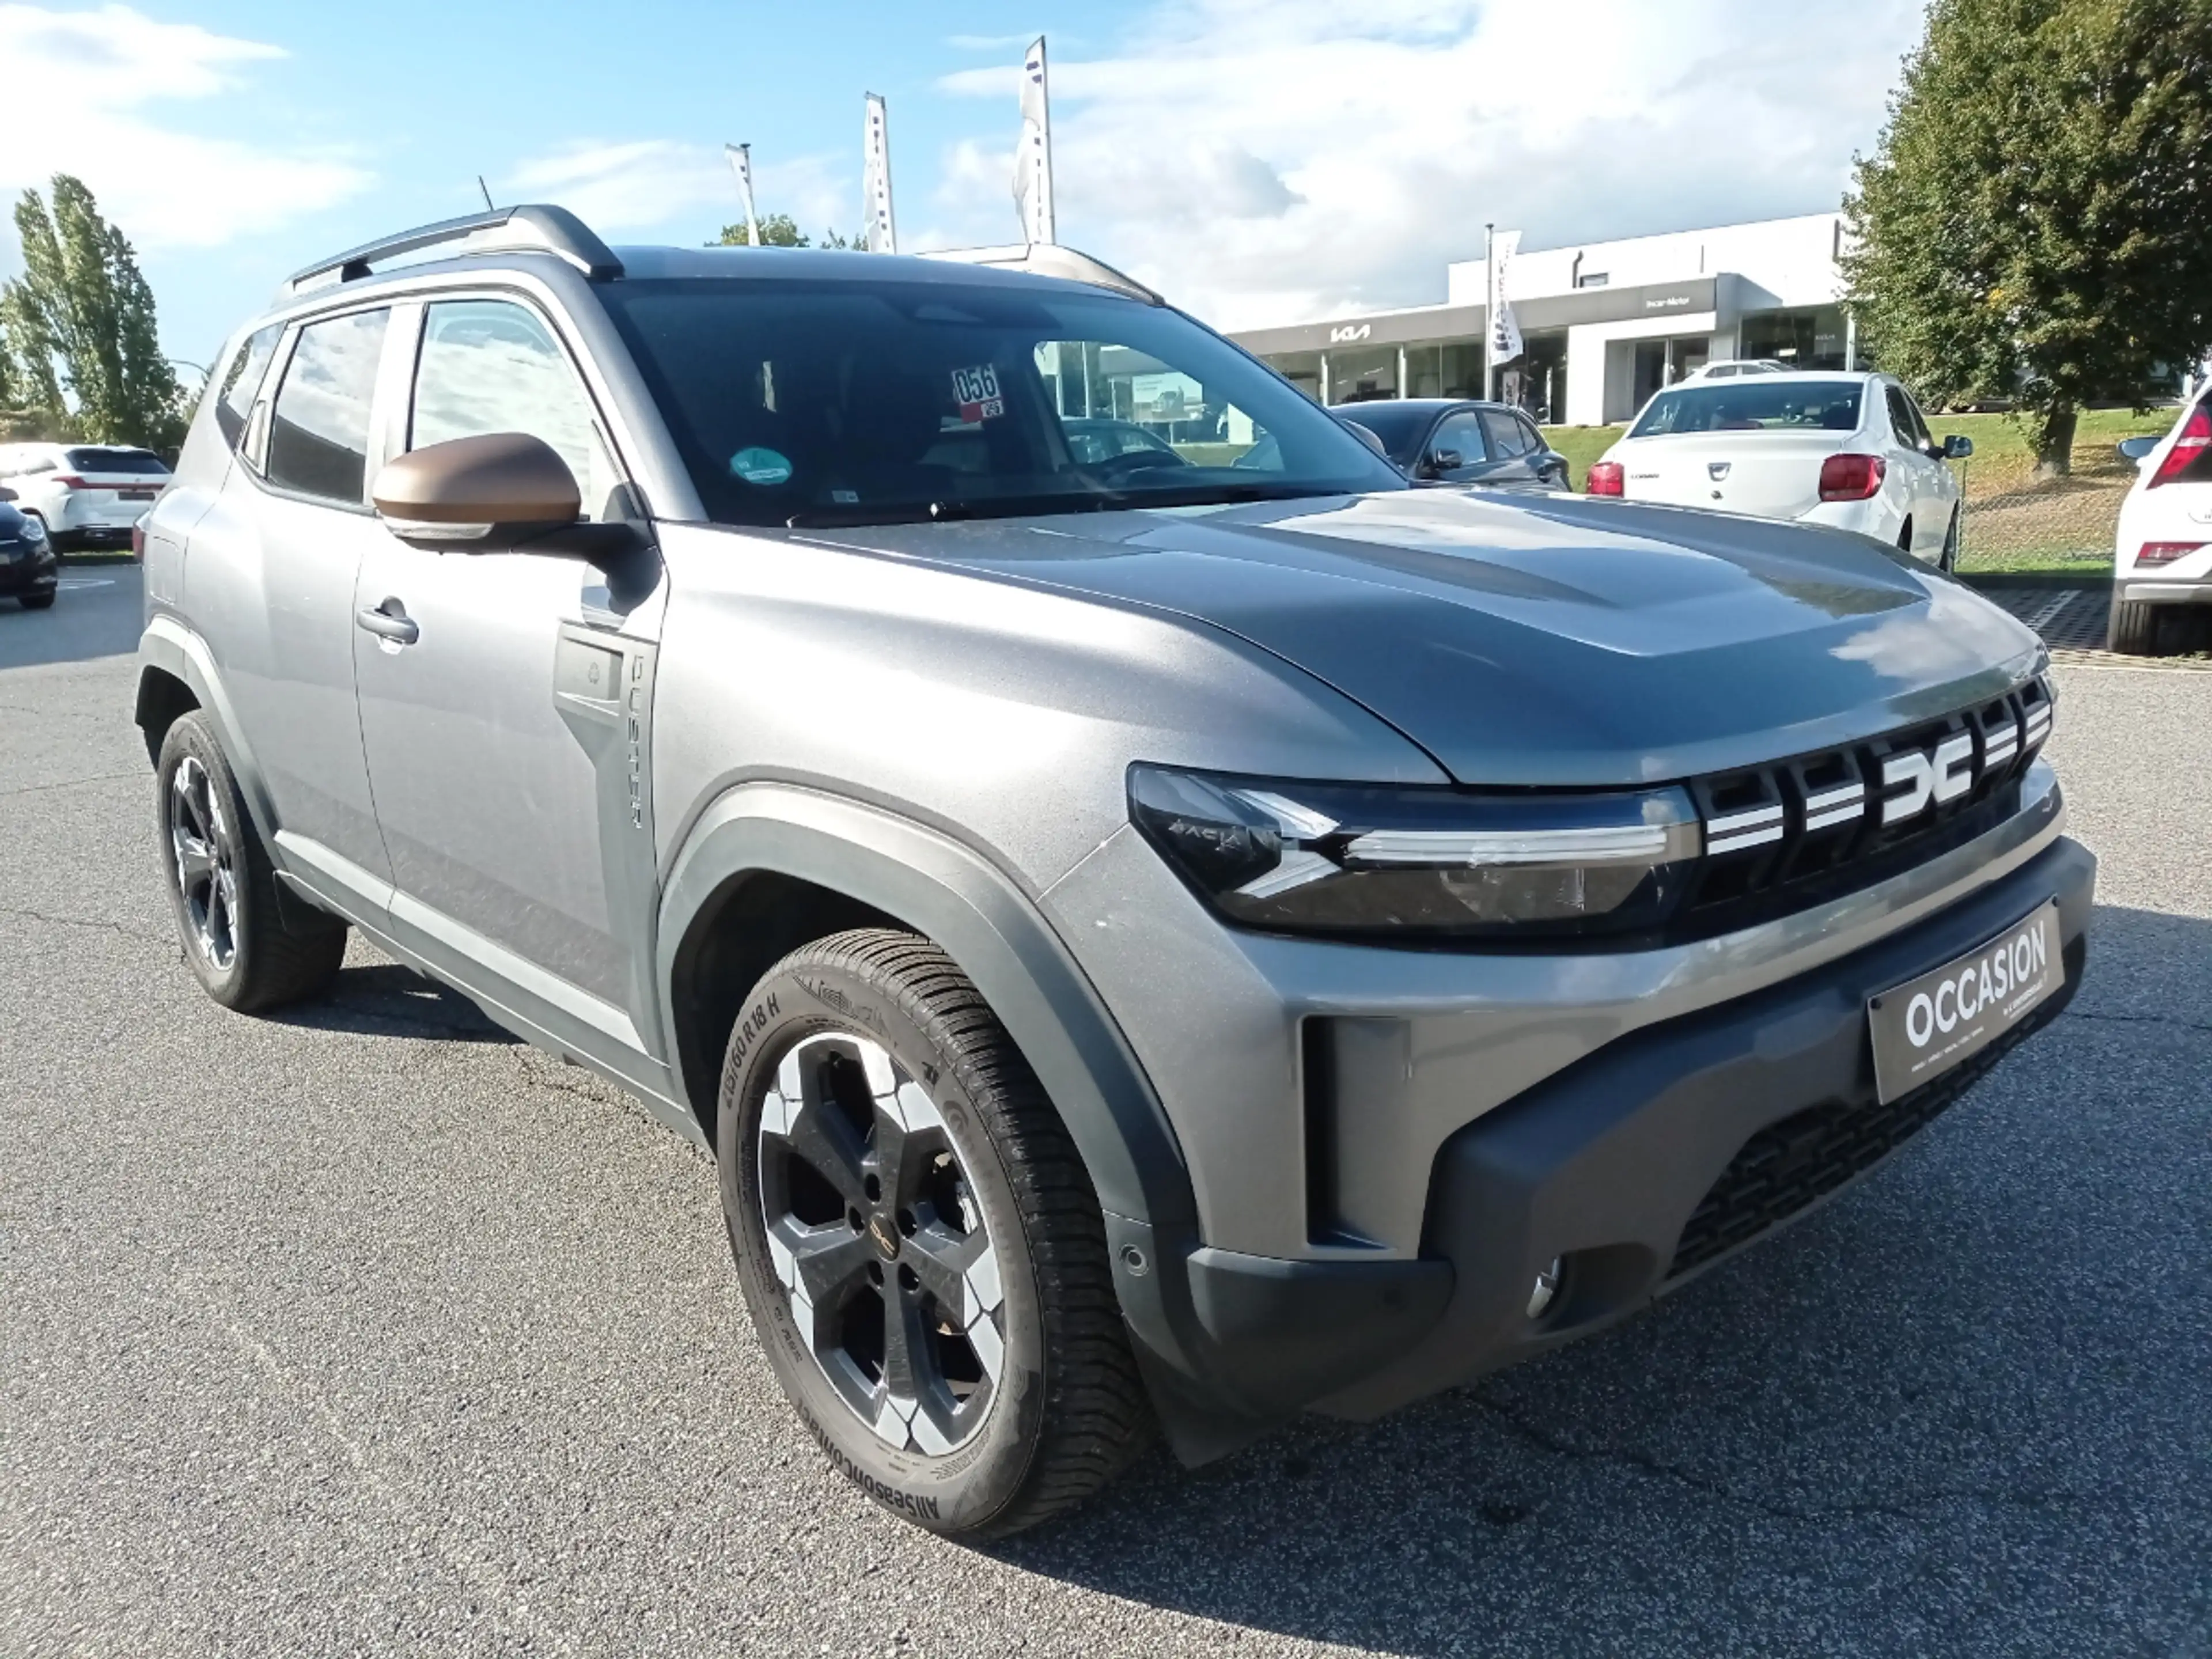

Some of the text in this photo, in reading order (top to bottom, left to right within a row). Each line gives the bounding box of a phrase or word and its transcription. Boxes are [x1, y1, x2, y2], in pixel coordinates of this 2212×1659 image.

[1331, 325, 1370, 342] KIA
[956, 365, 997, 403] 056
[628, 654, 645, 828] DUSTER
[1906, 921, 2046, 1047] OCCASION
